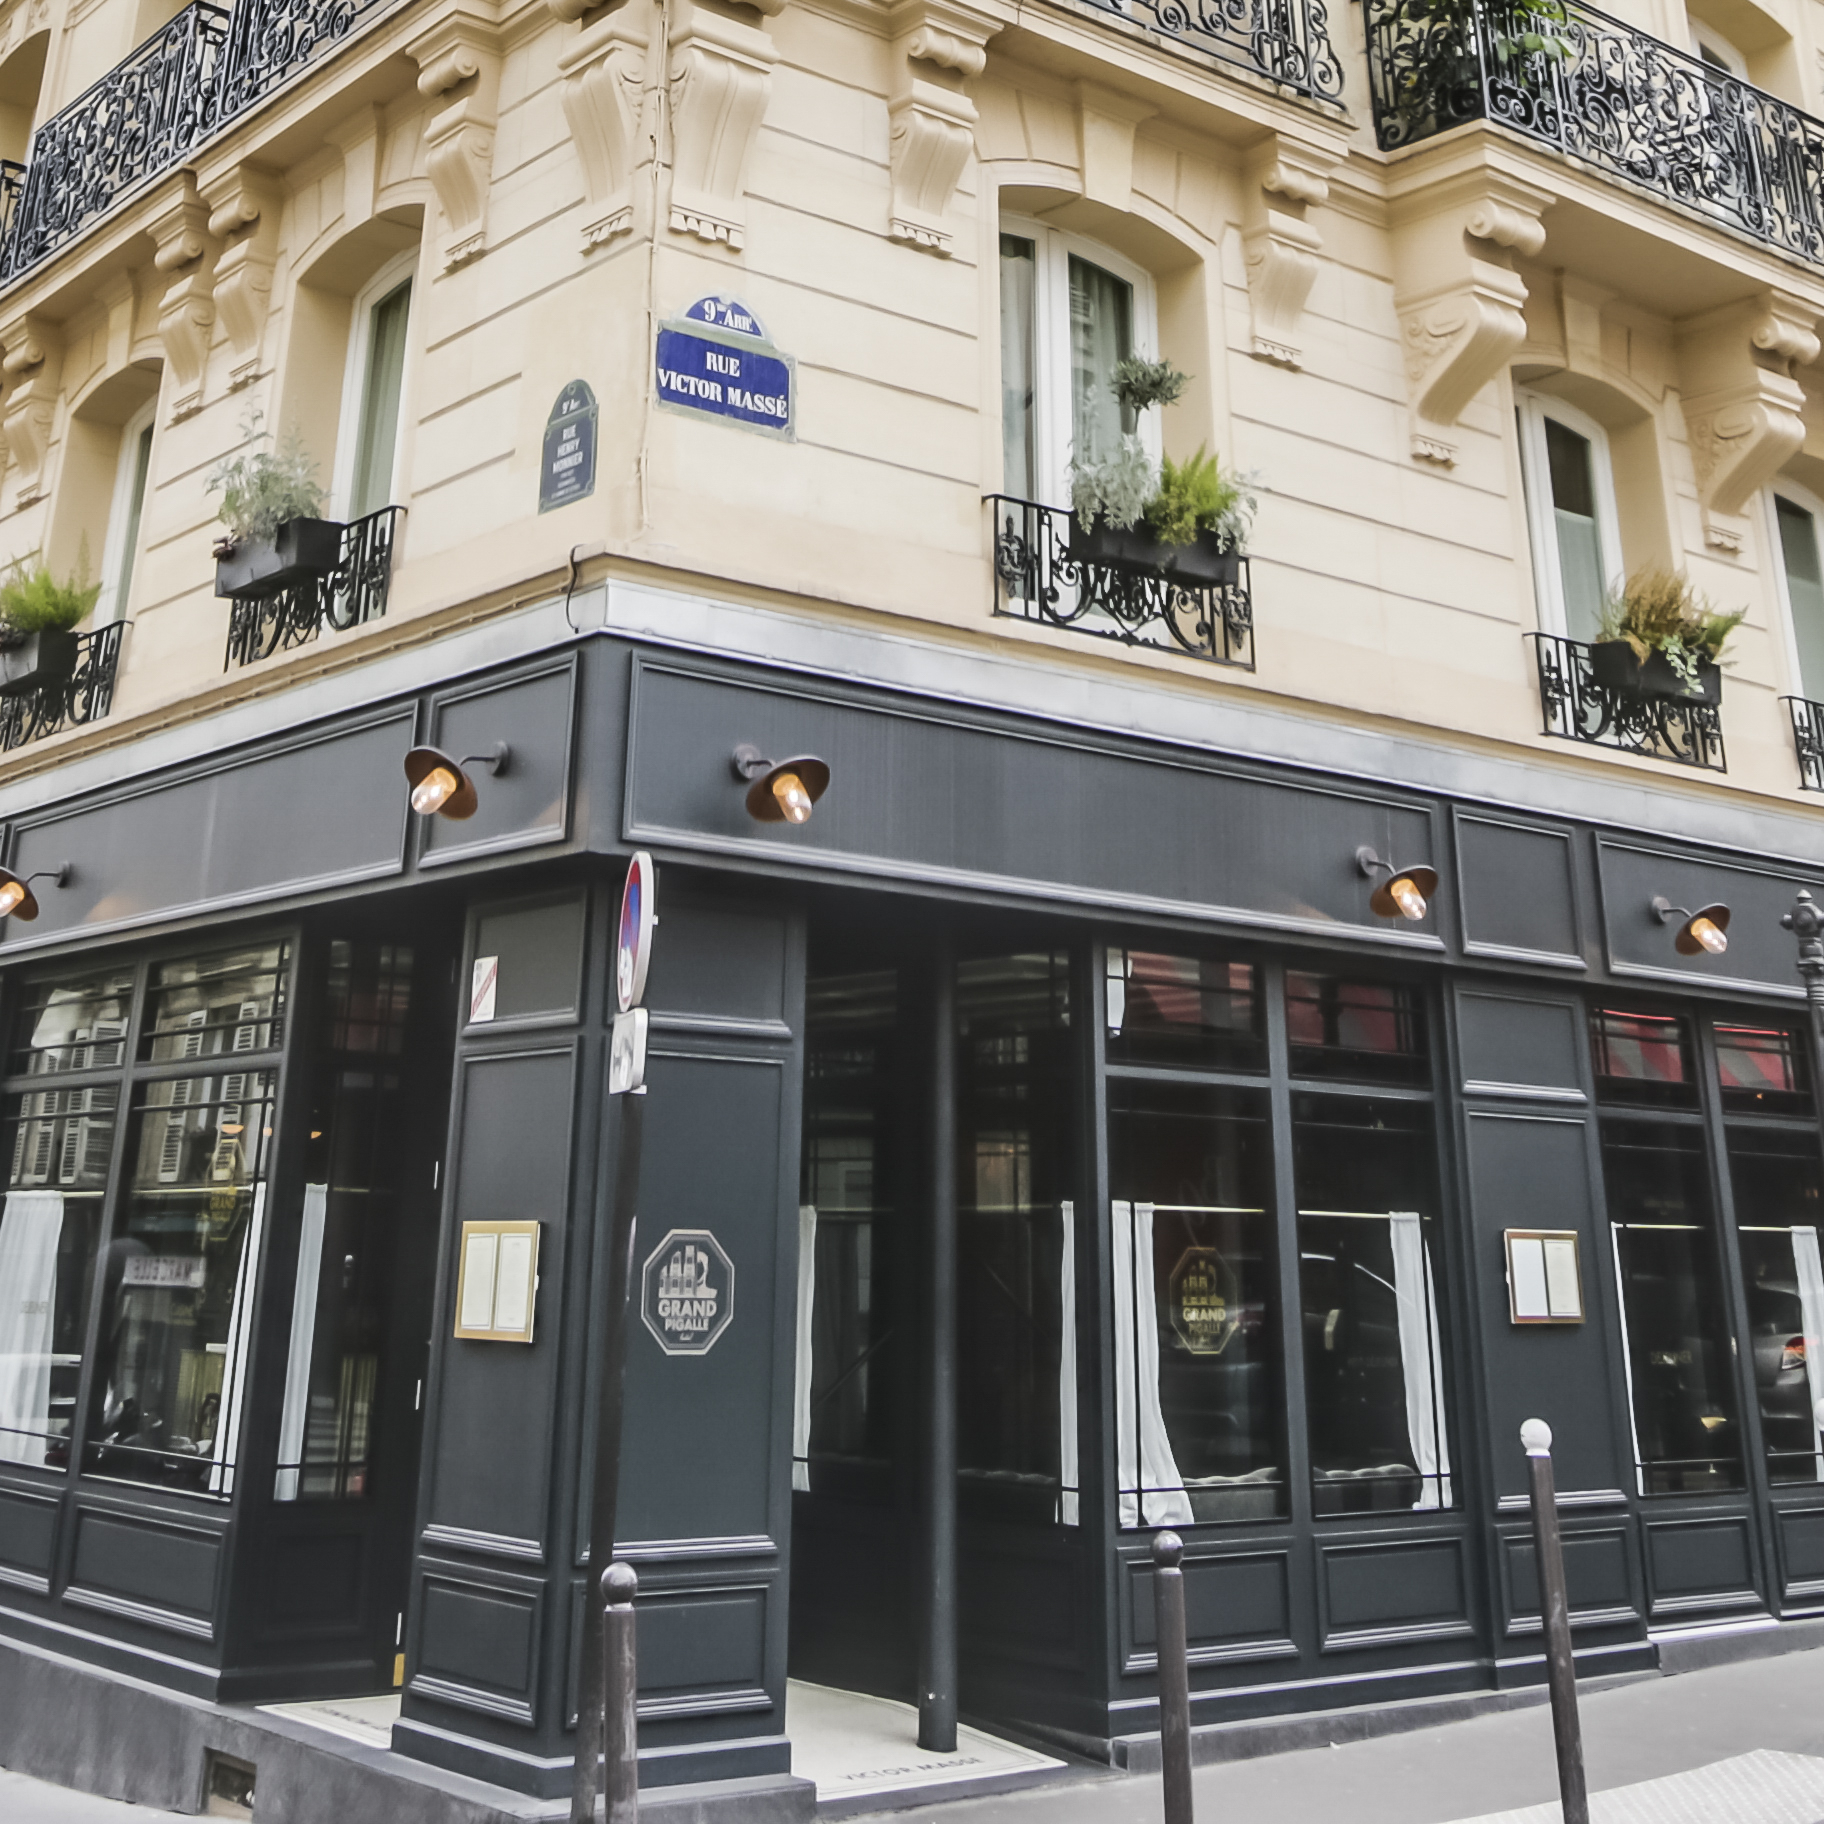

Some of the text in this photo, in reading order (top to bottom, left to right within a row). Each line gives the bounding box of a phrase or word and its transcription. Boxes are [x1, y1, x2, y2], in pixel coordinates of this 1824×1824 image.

[706, 351, 740, 377] RUE
[657, 368, 787, 419] VICTOR MASSÉ
[658, 1299, 717, 1317] GRAND
[1183, 1307, 1226, 1322] GRAND
[665, 1318, 709, 1331] PIGALLE
